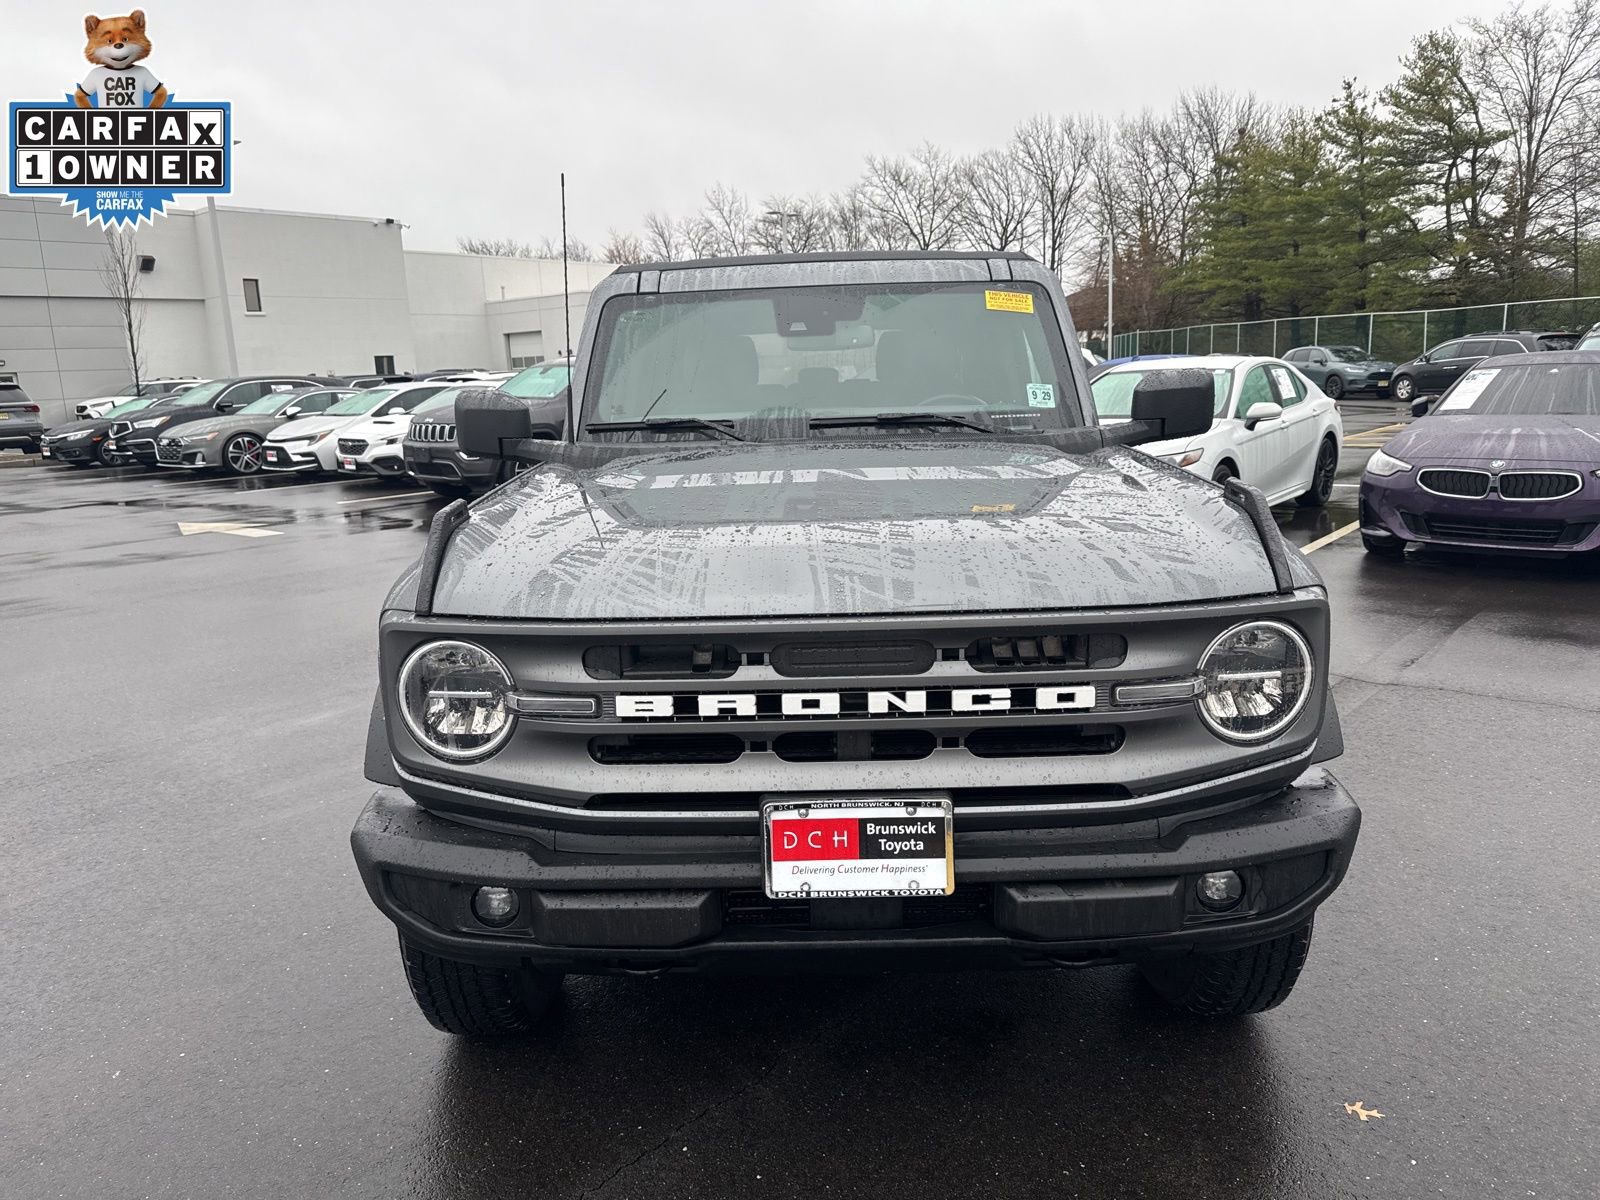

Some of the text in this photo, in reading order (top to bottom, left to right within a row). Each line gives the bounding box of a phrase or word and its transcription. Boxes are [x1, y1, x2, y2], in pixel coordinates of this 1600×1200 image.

[1032, 390, 1051, 401] 9 29
[615, 686, 1097, 718] BRONCO
[866, 821, 936, 835] Brunswick
[879, 838, 924, 854] Toyota
[792, 865, 835, 876] Delivering
[837, 864, 879, 874] Customer
[810, 889, 890, 897] BRUNSWICK
